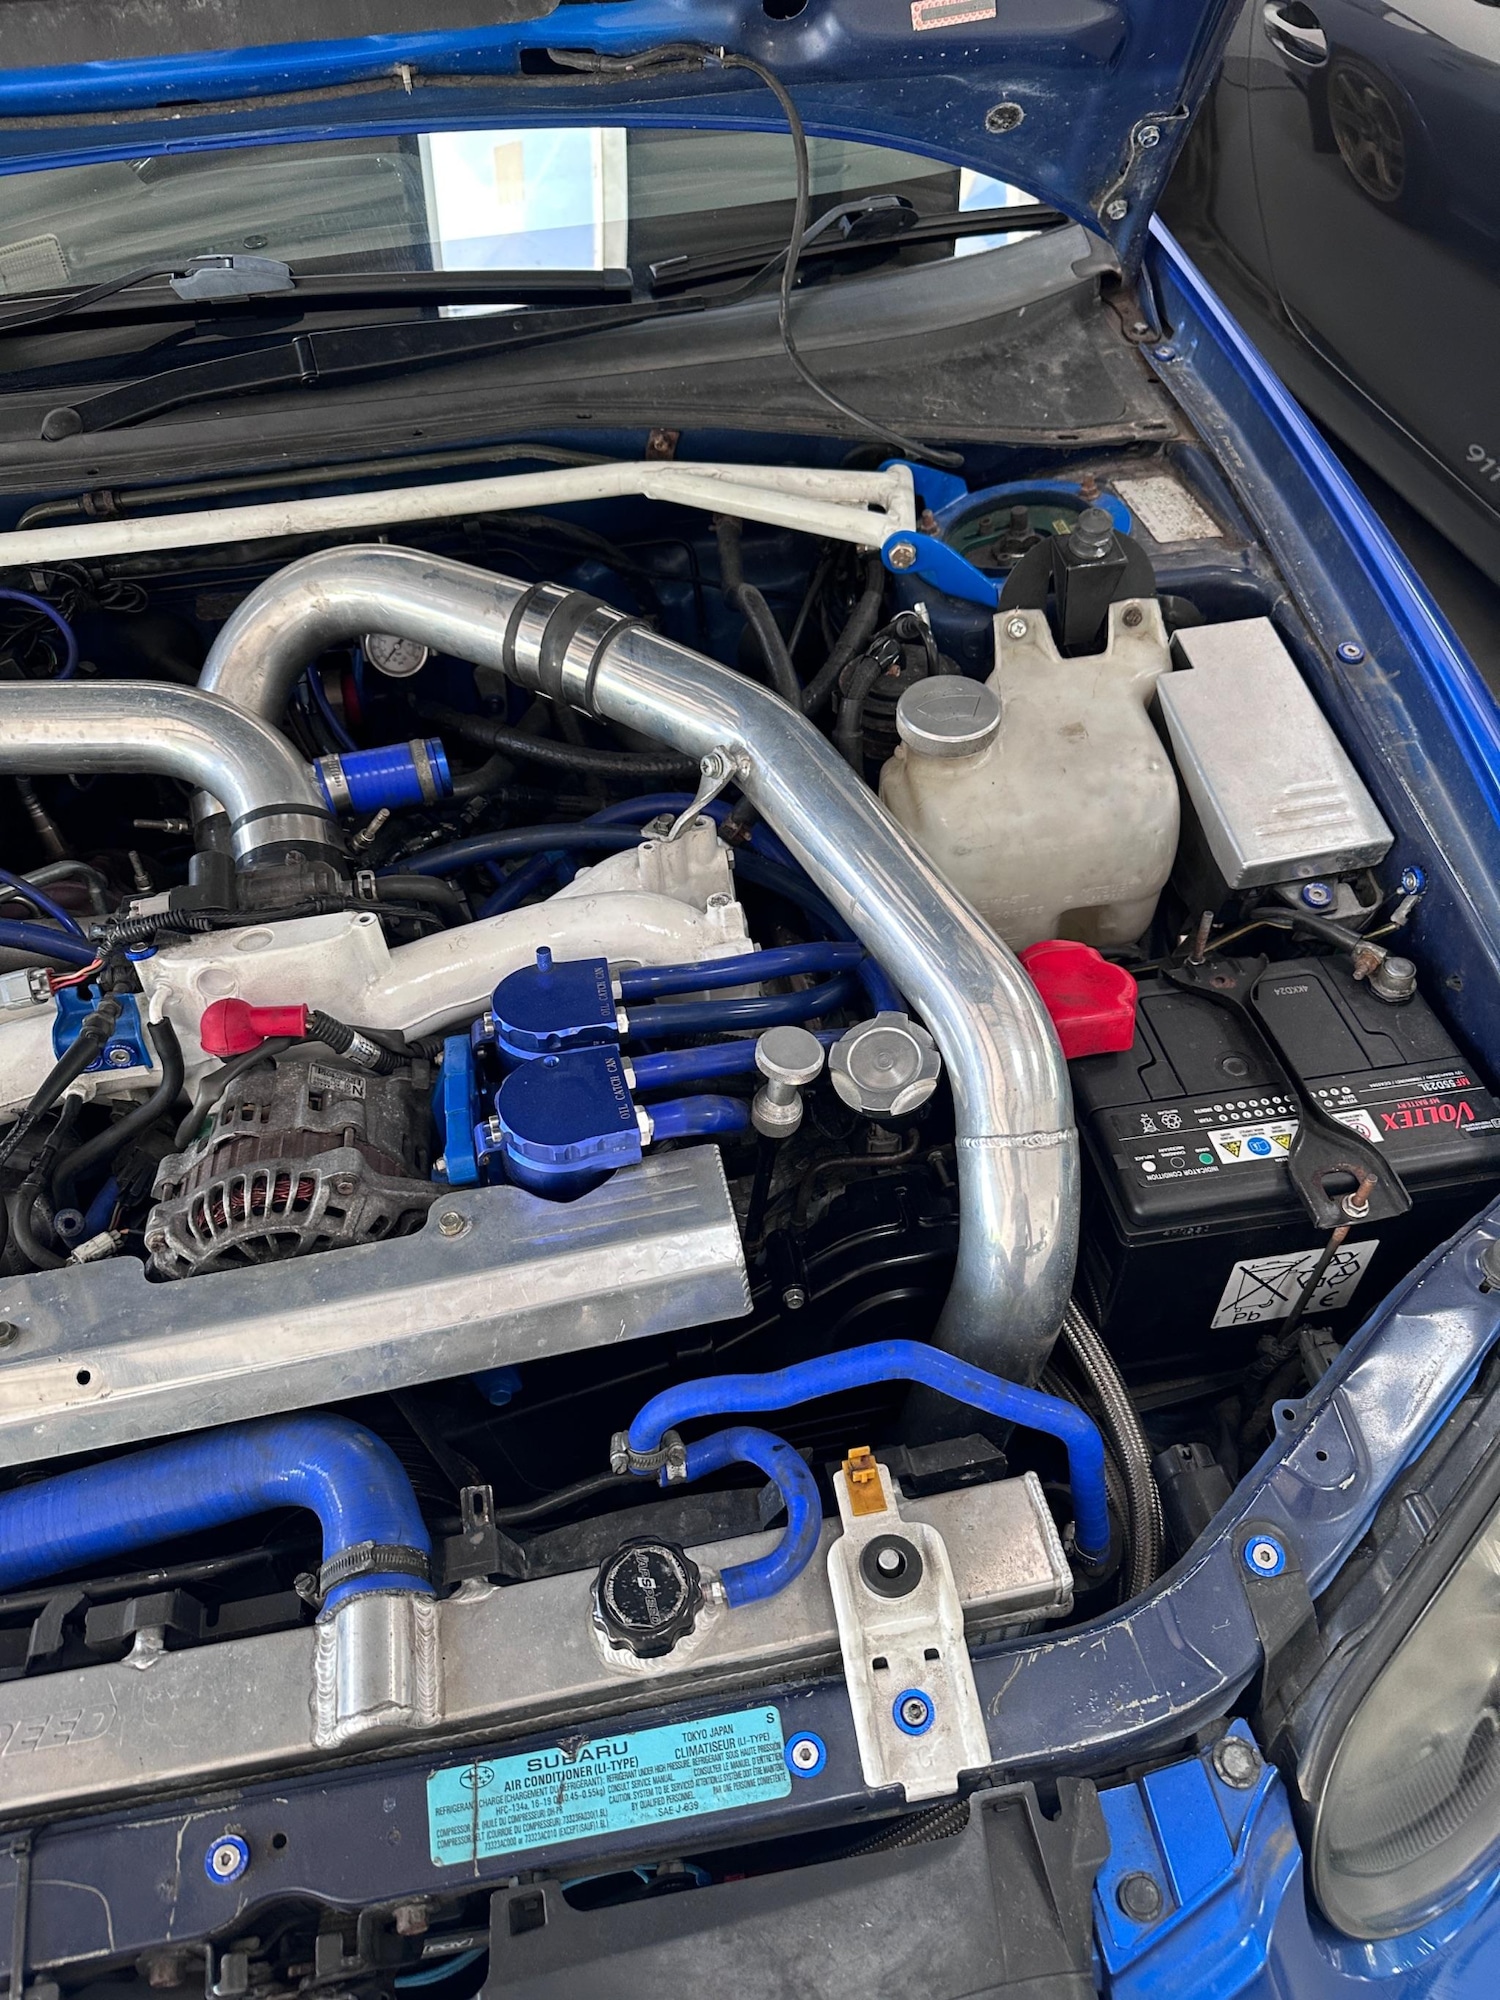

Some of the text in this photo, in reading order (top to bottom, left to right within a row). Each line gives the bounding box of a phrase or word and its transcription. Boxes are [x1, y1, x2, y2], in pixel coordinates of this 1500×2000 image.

[594, 966, 612, 1017] OIL CATCH CAN
[605, 1057, 631, 1120] OIL CATCH CAN
[1417, 1076, 1471, 1092] MF55D23L
[1397, 1098, 1431, 1109] BATTERY
[1380, 1101, 1475, 1132] VOLTEX
[1146, 1166, 1220, 1181] INDICATOR CONDITION
[1232, 1310, 1261, 1324] Pb
[765, 1711, 775, 1724] S
[681, 1723, 734, 1743] TOKYO JAPAN
[673, 1730, 770, 1759] CLIMATISEUR (LI-TYPE)
[526, 1740, 628, 1772] SUBARU
[503, 1754, 639, 1792] AIR CONDITIONER (LI-TYPE)
[637, 1765, 654, 1777] UNDER
[653, 1762, 666, 1774] HIGH
[434, 1799, 476, 1817] REFRIGERAN
[477, 1794, 504, 1808] CHARGE
[503, 1785, 548, 1804] (CHARGEMENT
[632, 1786, 654, 1800] SYSTEM
[654, 1785, 663, 1796] TO
[662, 1783, 670, 1794] BE
[530, 1796, 551, 1809] 16-19
[657, 1804, 674, 1817] SAE
[435, 1822, 471, 1839] COMPRESSOR
[498, 1815, 507, 1826] DU
[436, 1833, 472, 1850] COMPRESSOR
[513, 1823, 522, 1835] DU
